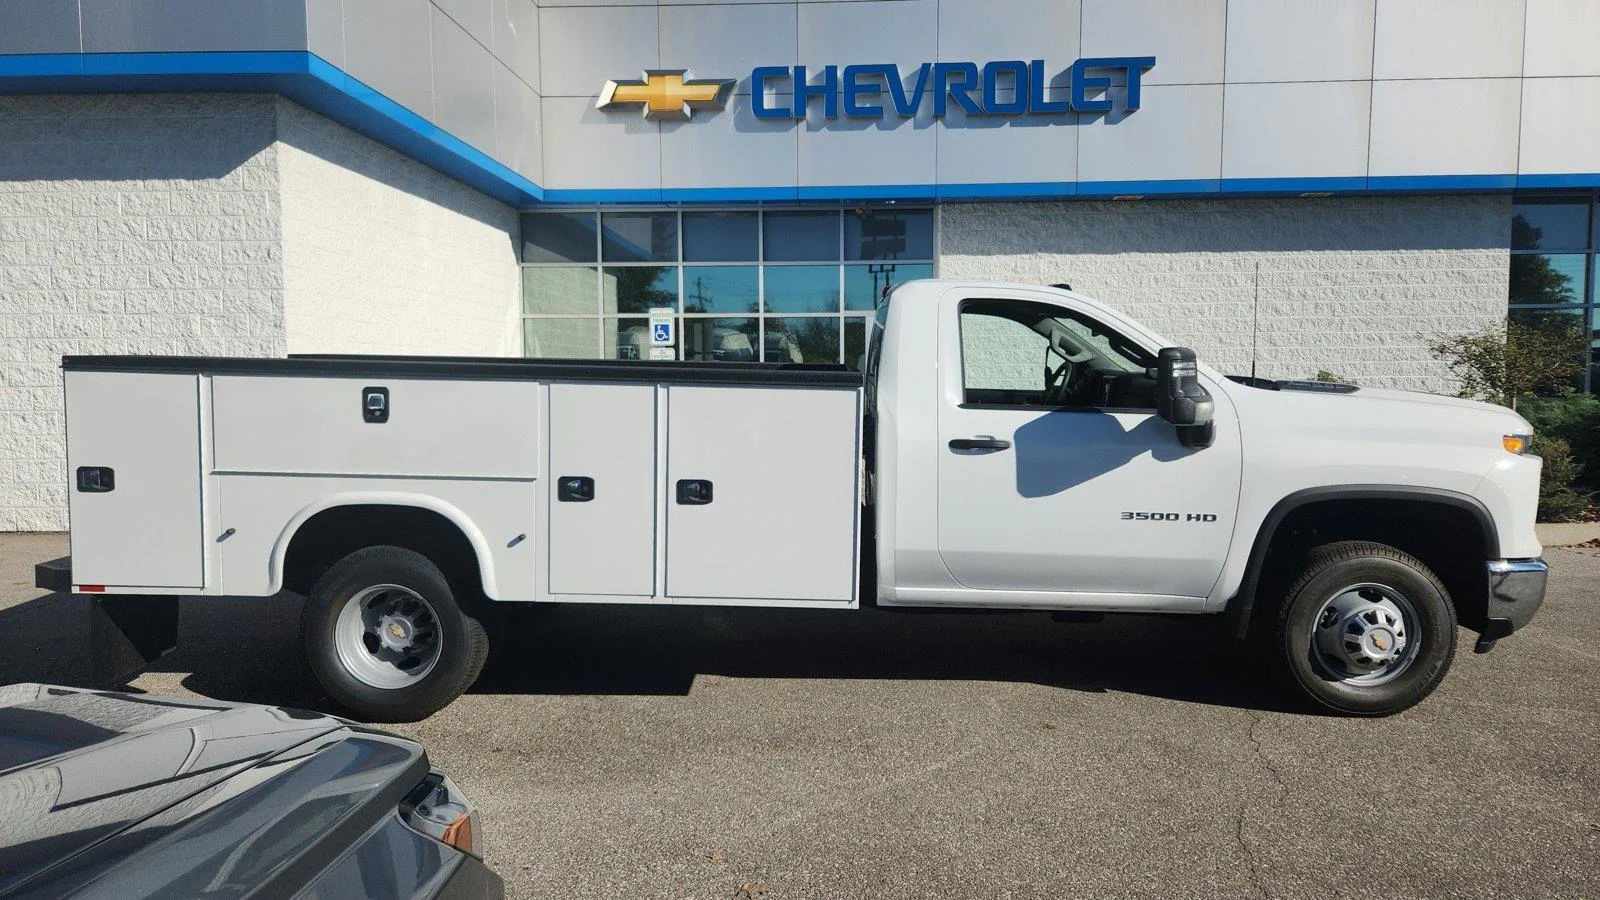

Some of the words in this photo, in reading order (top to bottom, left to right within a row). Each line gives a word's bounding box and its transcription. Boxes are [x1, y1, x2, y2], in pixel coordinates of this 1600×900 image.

[751, 56, 1156, 119] CHEVROLET
[1120, 511, 1180, 521] 3500
[1186, 513, 1217, 522] HD
